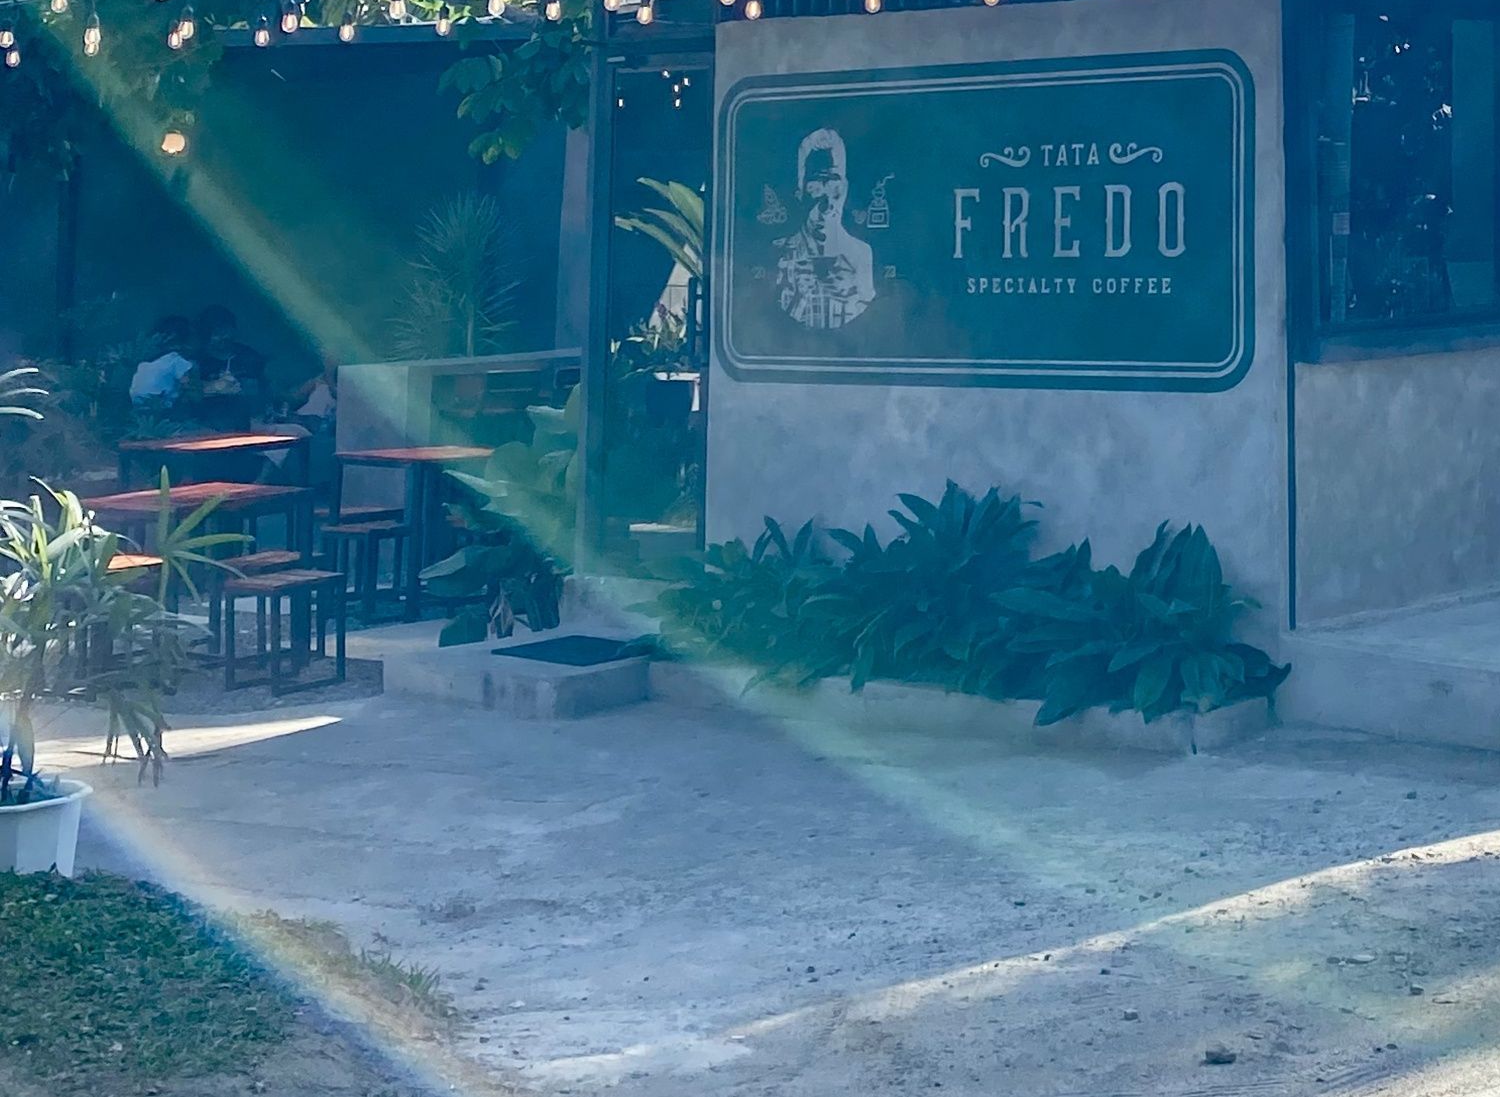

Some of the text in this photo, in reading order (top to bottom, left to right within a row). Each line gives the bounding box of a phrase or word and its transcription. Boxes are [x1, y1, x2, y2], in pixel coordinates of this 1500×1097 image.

[1041, 142, 1100, 167] TATA
[953, 181, 1186, 259] FREDO
[967, 277, 1172, 294] SPECIALTY COFFEE
